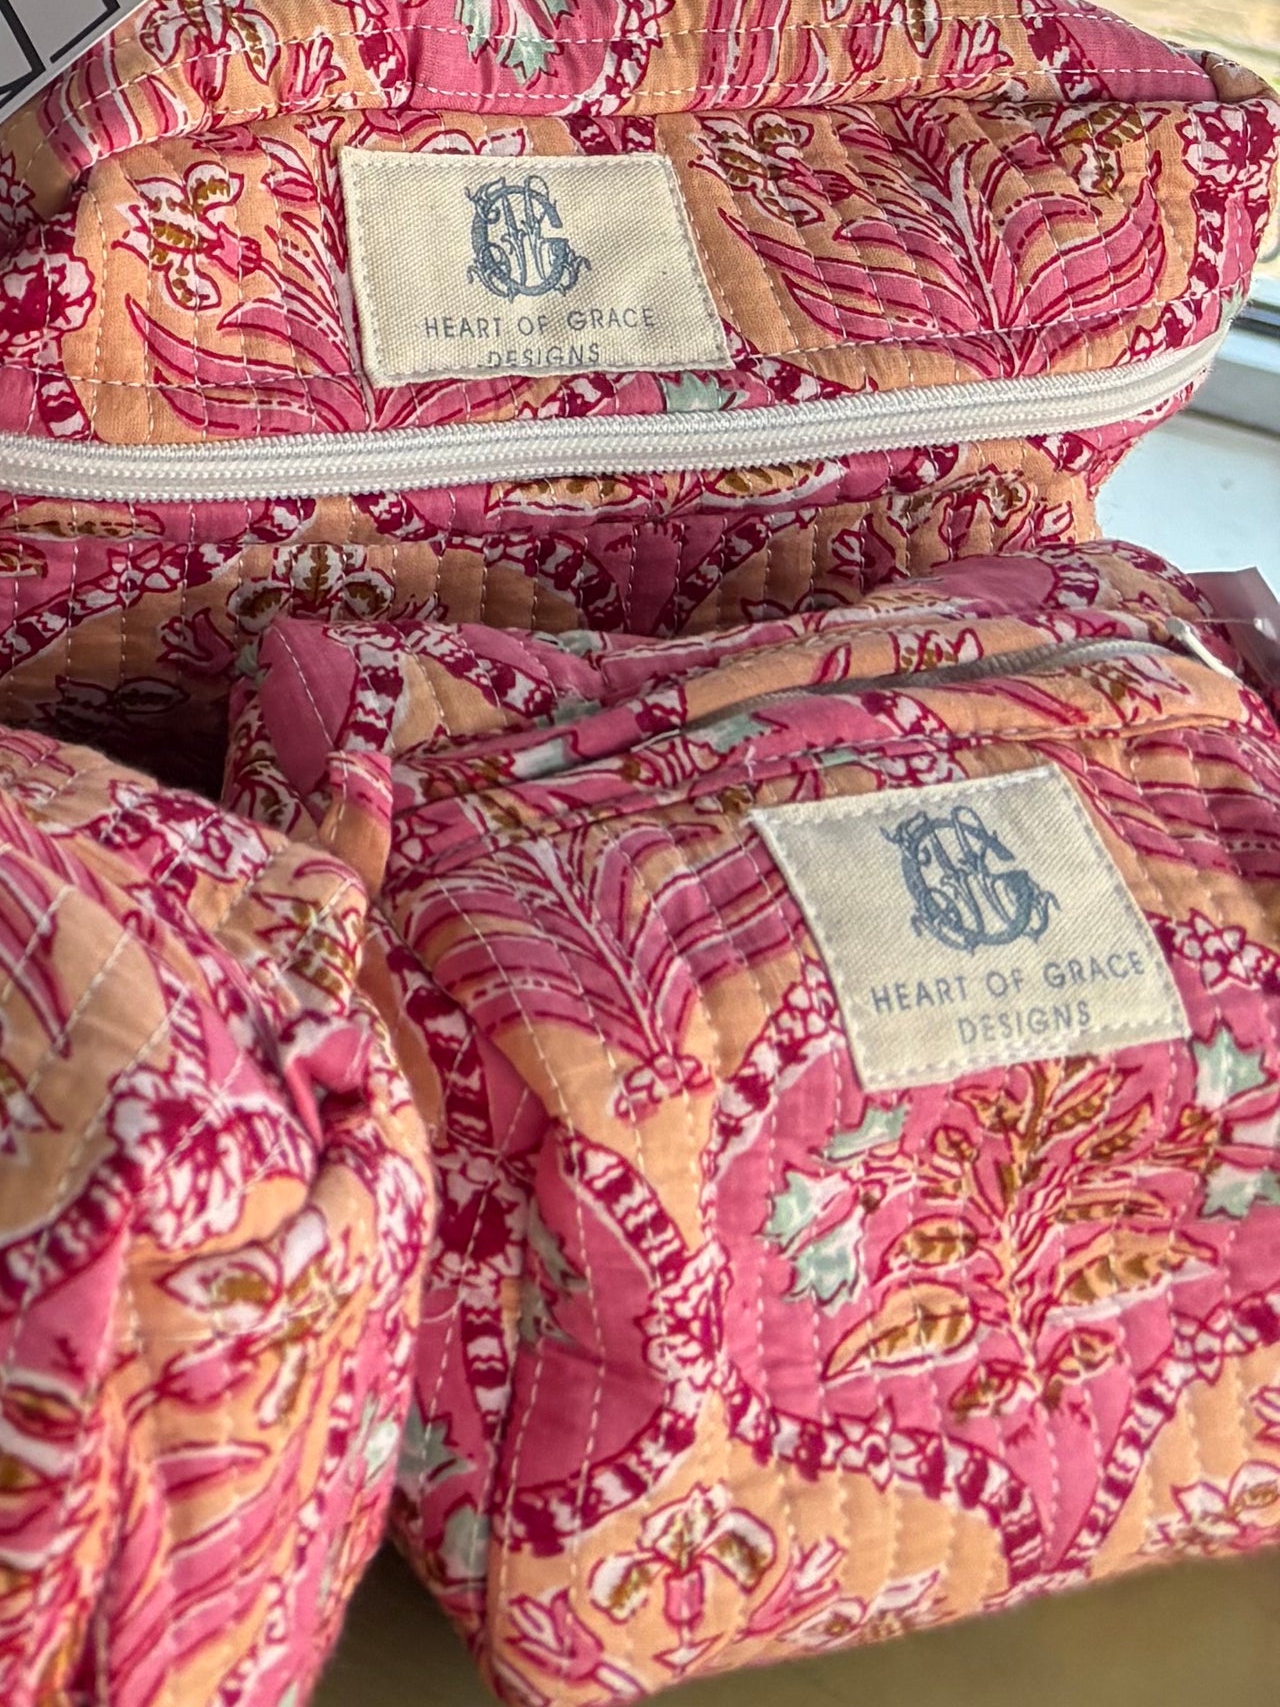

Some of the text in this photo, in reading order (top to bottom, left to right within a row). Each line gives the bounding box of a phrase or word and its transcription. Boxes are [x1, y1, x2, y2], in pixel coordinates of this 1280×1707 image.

[424, 307, 657, 338] HEART OF GRACE
[487, 342, 601, 368] DESIGNS
[870, 949, 1146, 1015] HEART OF GRACE
[957, 1000, 1091, 1045] DESIGNS
